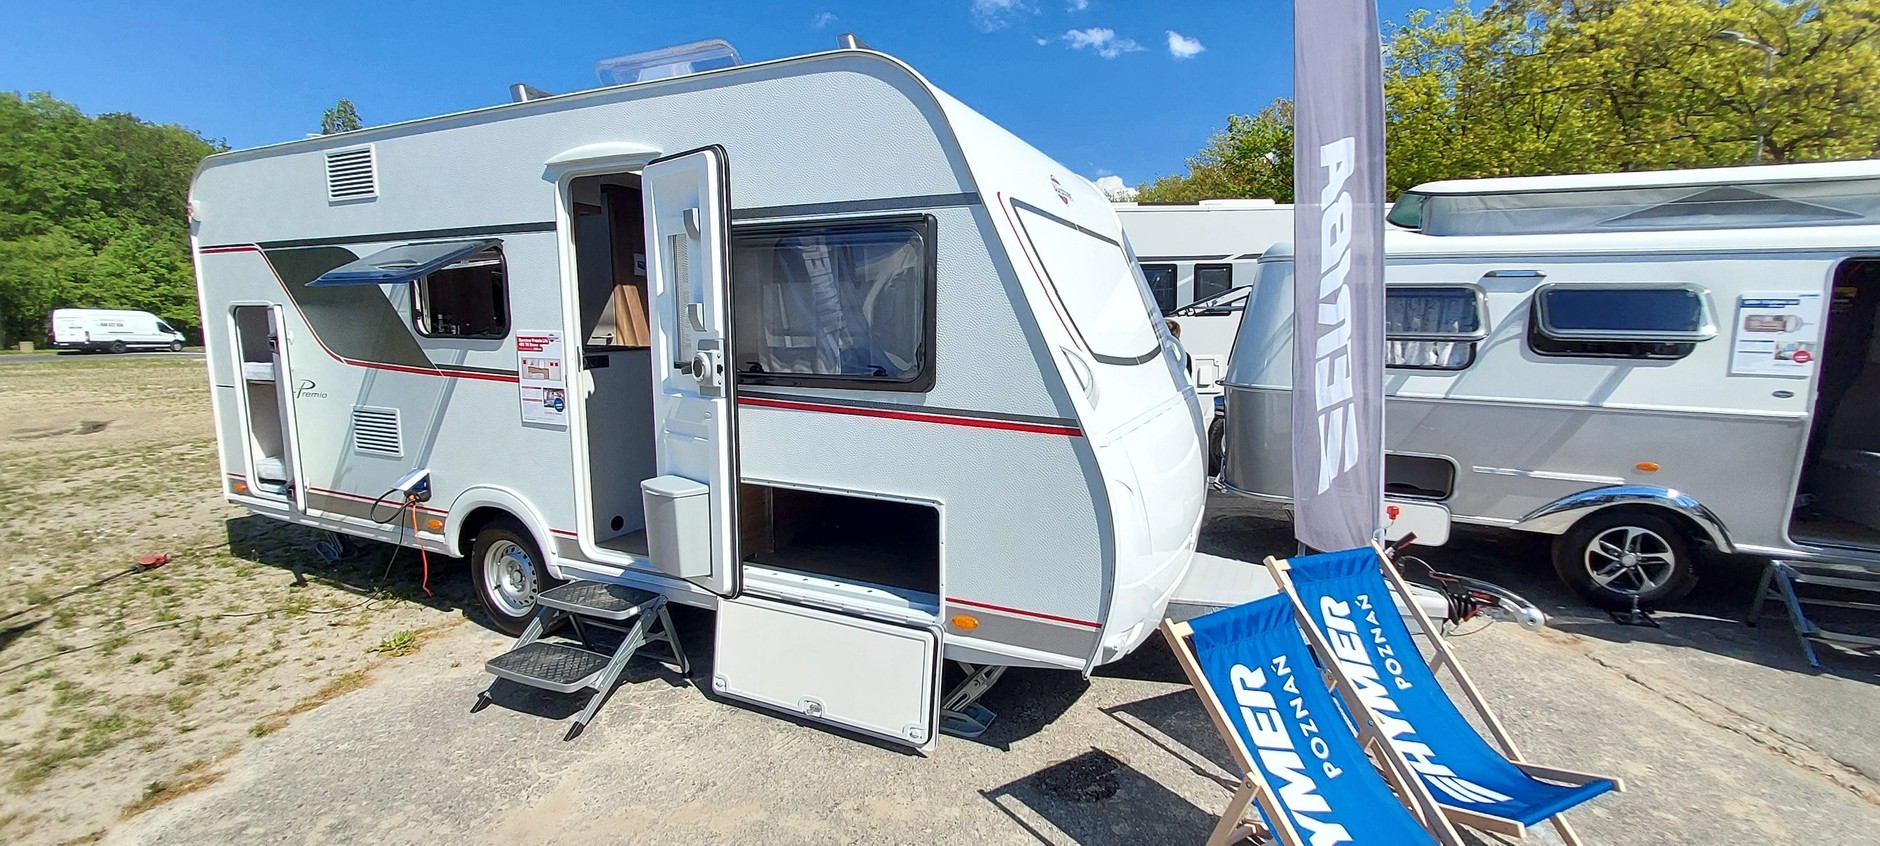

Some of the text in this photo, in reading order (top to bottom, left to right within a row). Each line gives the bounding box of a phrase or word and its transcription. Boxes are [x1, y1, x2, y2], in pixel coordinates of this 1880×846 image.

[297, 379, 328, 399] Premio
[1320, 595, 1457, 777] HYMER
[1355, 594, 1413, 690] POZNAŃ
[1271, 655, 1344, 779] POZNAŃ
